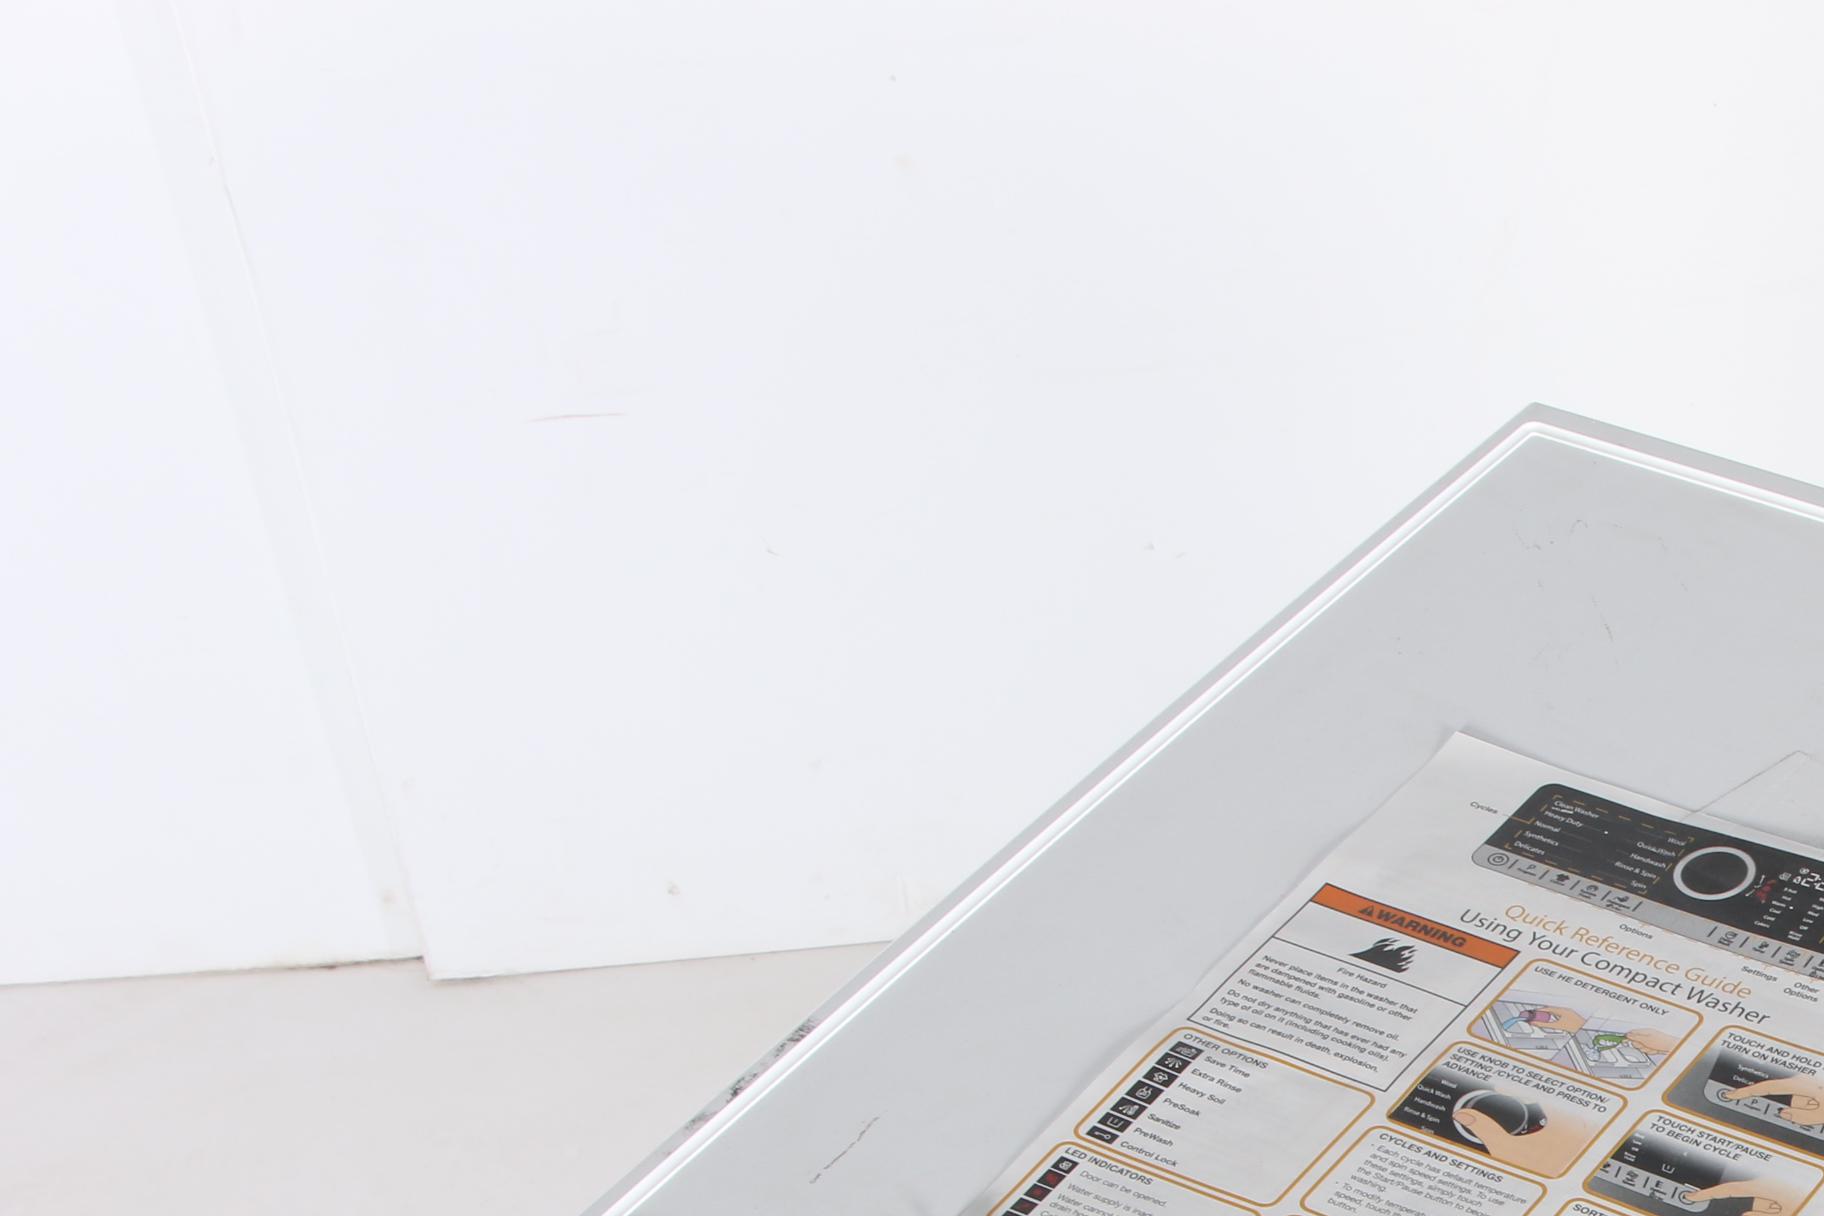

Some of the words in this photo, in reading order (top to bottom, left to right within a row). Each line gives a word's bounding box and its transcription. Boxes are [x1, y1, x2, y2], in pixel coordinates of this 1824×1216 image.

[1469, 800, 1498, 814] Cycles
[1376, 909, 1466, 947] WARNING
[1618, 923, 1653, 940] Options
[1459, 908, 1523, 943] Using
[1527, 930, 1579, 958] Your
[1579, 951, 1683, 996] Compact
[1686, 985, 1771, 1024] Washer
[1504, 904, 1569, 936] Quick
[1569, 926, 1680, 974] Reference
[1683, 966, 1752, 999] Guide
[1740, 965, 1778, 982] Settings
[1793, 981, 1820, 994] Other
[1533, 965, 1558, 978] USE
[1556, 973, 1574, 984] HE
[1572, 978, 1639, 1005] DETERGENT
[1638, 1001, 1669, 1016] ONLY
[1782, 986, 1818, 1003] Options
[1182, 1032, 1221, 1051] OTHER
[1220, 1047, 1268, 1069] OPTIONS
[1720, 1039, 1751, 1055] TURN
[1751, 1050, 1769, 1061] ON
[1769, 1056, 1817, 1076] WASHER
[1727, 1031, 1766, 1050] TOUCH
[1764, 1045, 1790, 1058] AND
[1790, 1053, 1822, 1068] HOLD
[1190, 1067, 1215, 1082] Extra
[1215, 1078, 1242, 1093] Rinse
[1204, 1055, 1227, 1068] Save
[1228, 1064, 1250, 1078] Time
[1441, 1060, 1492, 1082] ADVANCE
[1456, 1046, 1479, 1058] USE
[1478, 1054, 1510, 1069] KNOB
[1510, 1064, 1525, 1074] TO
[1524, 1070, 1566, 1088] SELECT
[1565, 1084, 1609, 1104] OPTION/
[1177, 1081, 1206, 1098] Heavy
[1206, 1093, 1226, 1105] Soil
[1449, 1053, 1494, 1073] SETTING
[1492, 1069, 1533, 1086] /CYCLE
[1530, 1082, 1556, 1094] AND
[1555, 1090, 1591, 1107] PRESS
[1591, 1102, 1607, 1113] TO
[1147, 1113, 1181, 1130] Sanitize
[1162, 1097, 1200, 1116] PreSoak
[1132, 1126, 1173, 1146] PreWash
[1649, 1122, 1666, 1133] TO
[1665, 1129, 1702, 1147] BEGIN
[1702, 1143, 1741, 1161] CYCLE
[1656, 1115, 1696, 1135] TOUCH
[1696, 1130, 1772, 1162] START/PAUSE
[1064, 1146, 1088, 1160] LED
[1086, 1155, 1153, 1185] INDICATORS
[1119, 1140, 1155, 1158] Control
[1153, 1153, 1177, 1167] Lock
[1378, 1132, 1423, 1153] CYCLES
[1422, 1149, 1448, 1162] AND
[1448, 1158, 1503, 1183] SETTINGS
